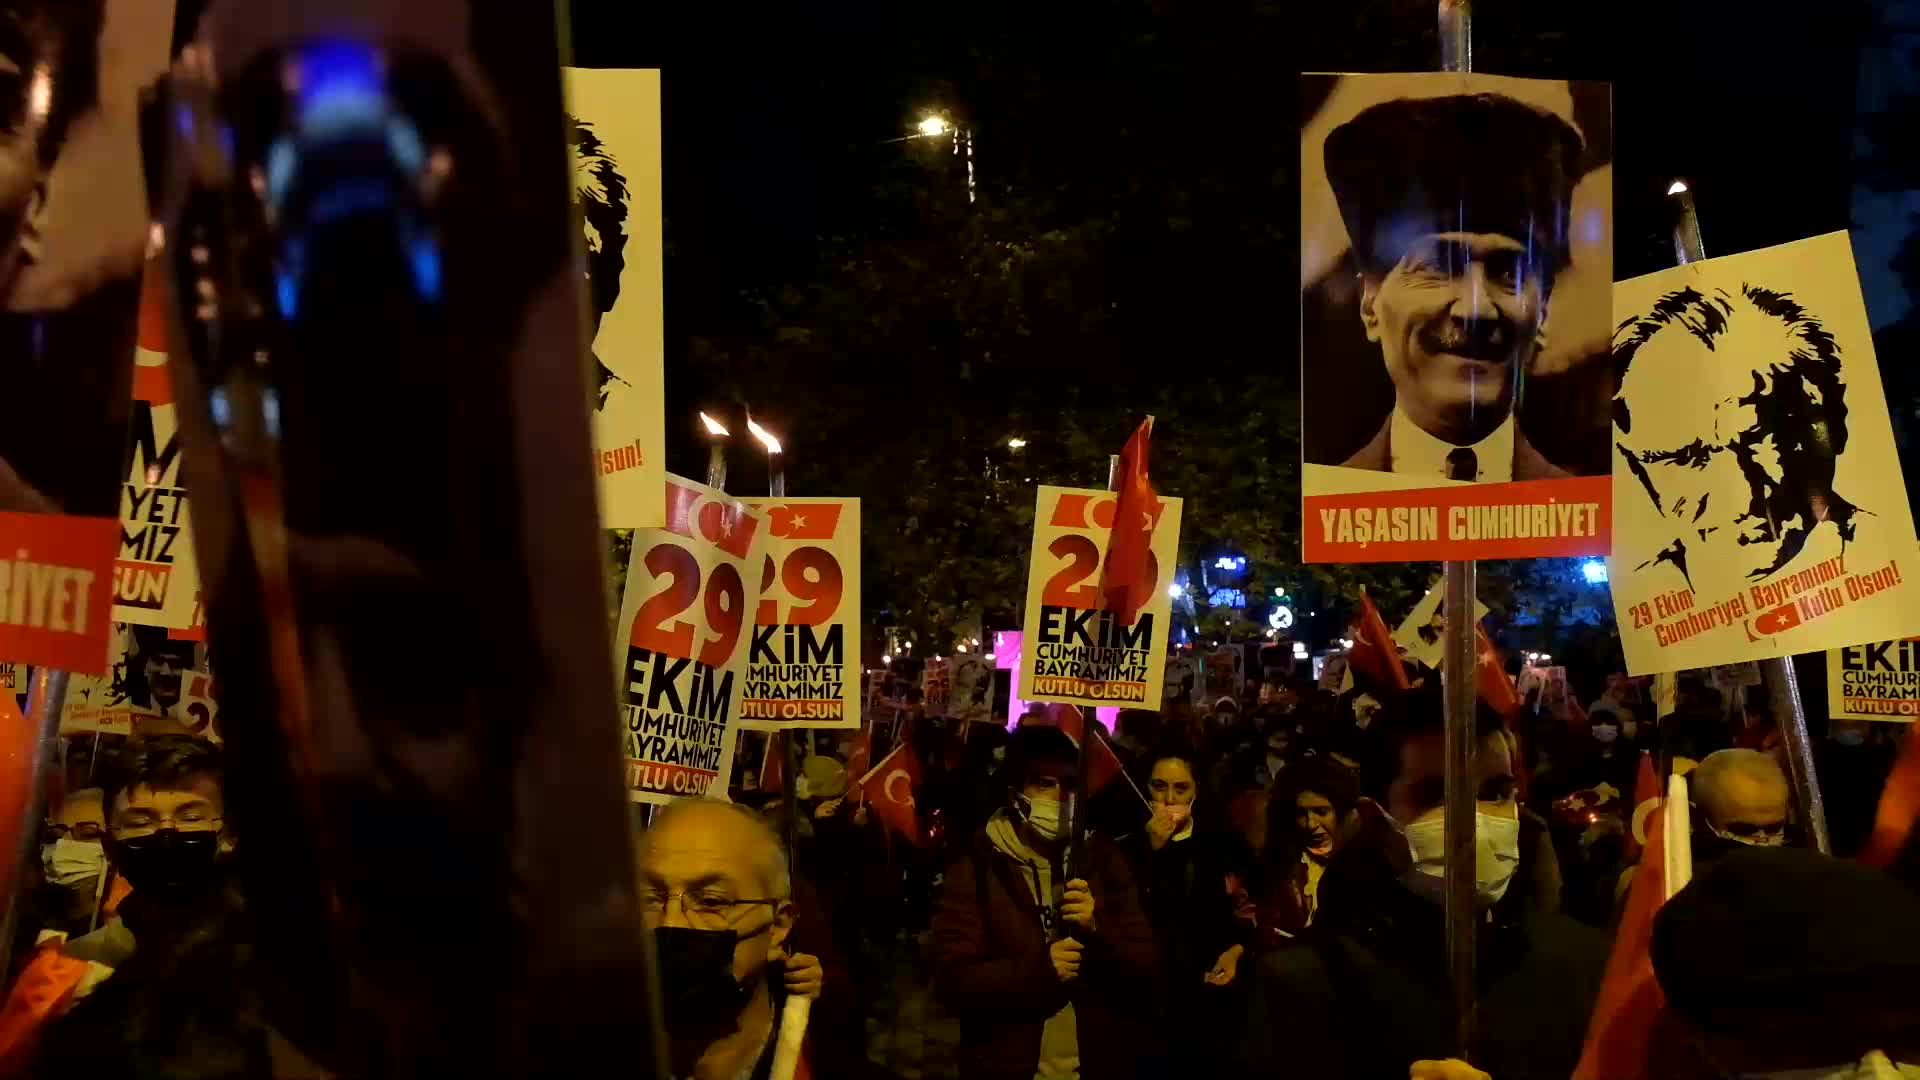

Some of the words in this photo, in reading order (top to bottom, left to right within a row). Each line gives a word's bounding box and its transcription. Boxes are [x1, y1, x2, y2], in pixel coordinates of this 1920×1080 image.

[121, 485, 188, 524] YET
[1319, 506, 1438, 549] YAŞASIN
[1448, 497, 1600, 541] CUMHURİYET
[120, 525, 180, 563] MIZ
[631, 543, 744, 670] 29
[1629, 600, 1653, 630] 29
[1654, 588, 1695, 620] Ekim
[1799, 586, 1844, 621] Kutlu
[1847, 559, 1903, 602] Olsun!
[1038, 605, 1154, 651] EKİM
[1654, 592, 1750, 648] Cumhuriyet
[749, 624, 843, 664] KİM
[1037, 643, 1150, 666] CUMHURİYET
[746, 665, 843, 682] MHURİYET
[1034, 659, 1148, 682] BAYRAMIMIZ
[1034, 679, 1085, 696] KUTLU
[1089, 682, 1144, 700] OLSUN
[1842, 671, 1920, 686] CUMHUR
[625, 704, 725, 747] UMHURİYET
[782, 703, 840, 718] OLSUN
[1845, 700, 1894, 714] KUTLU
[1898, 702, 1920, 715] OL
[631, 763, 669, 791] TLU
